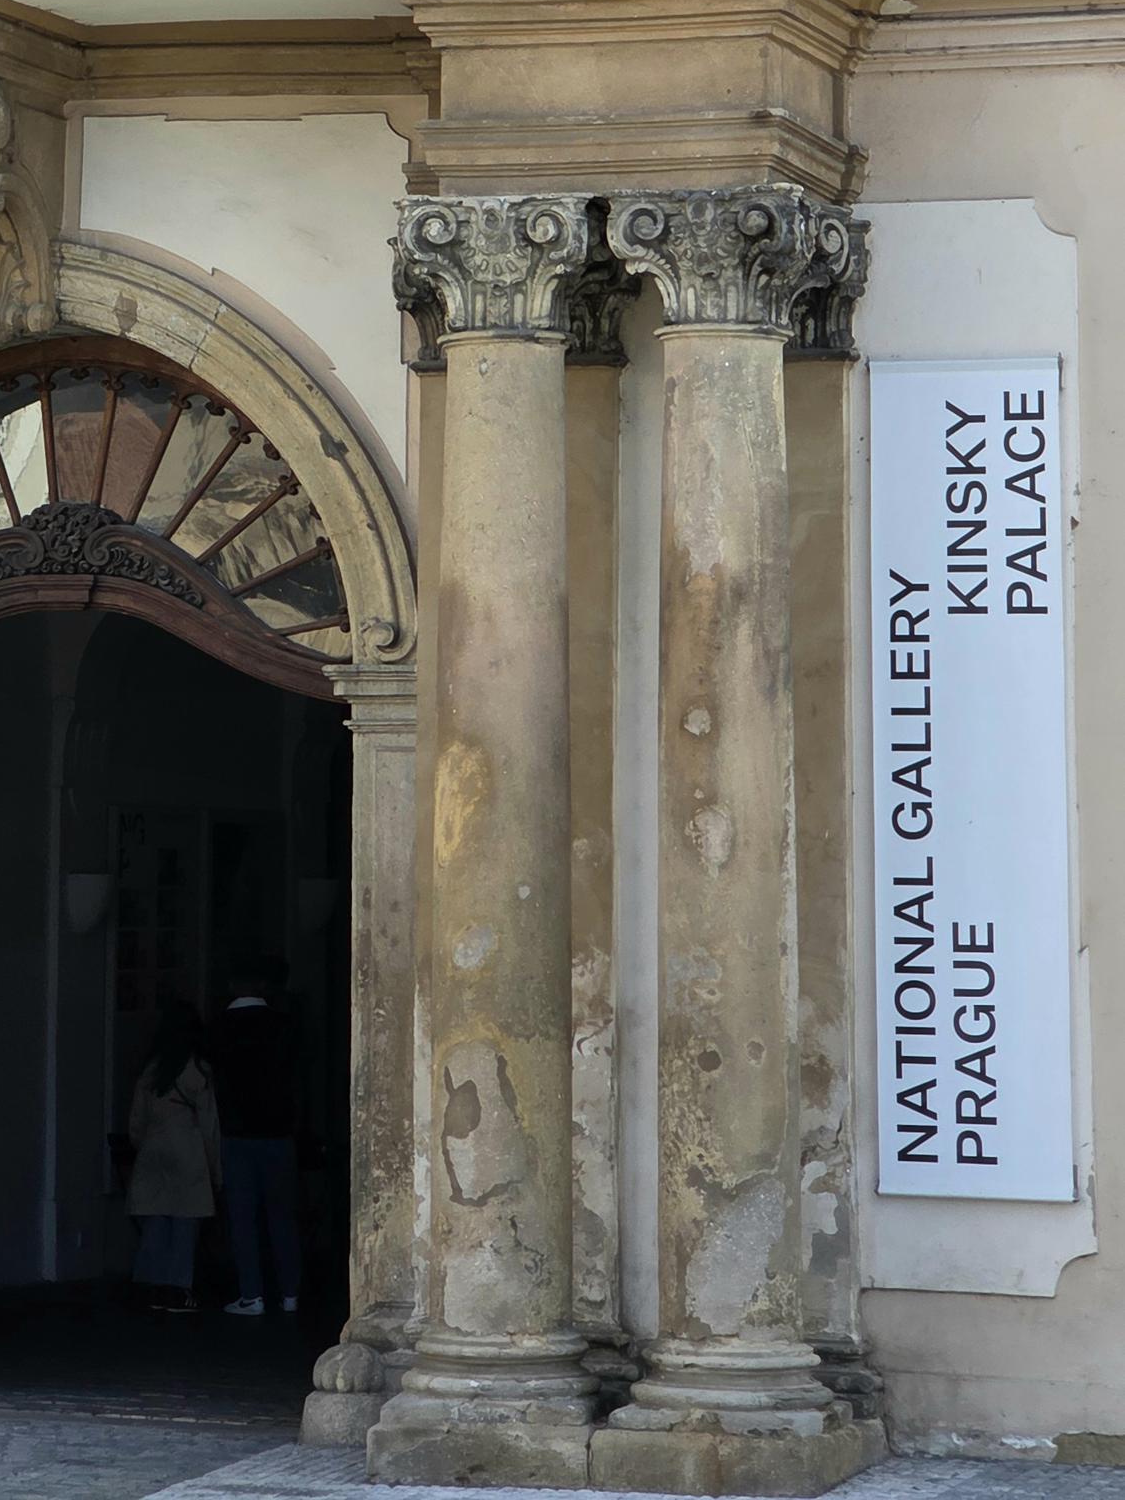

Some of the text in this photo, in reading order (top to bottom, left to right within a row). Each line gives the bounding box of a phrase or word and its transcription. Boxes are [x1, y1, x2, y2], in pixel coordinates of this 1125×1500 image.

[945, 400, 989, 615] KINSKY
[1003, 389, 1048, 615] PALACE
[889, 568, 939, 1164] NATIONAL GALLERY
[951, 921, 998, 1166] PRAGUE
